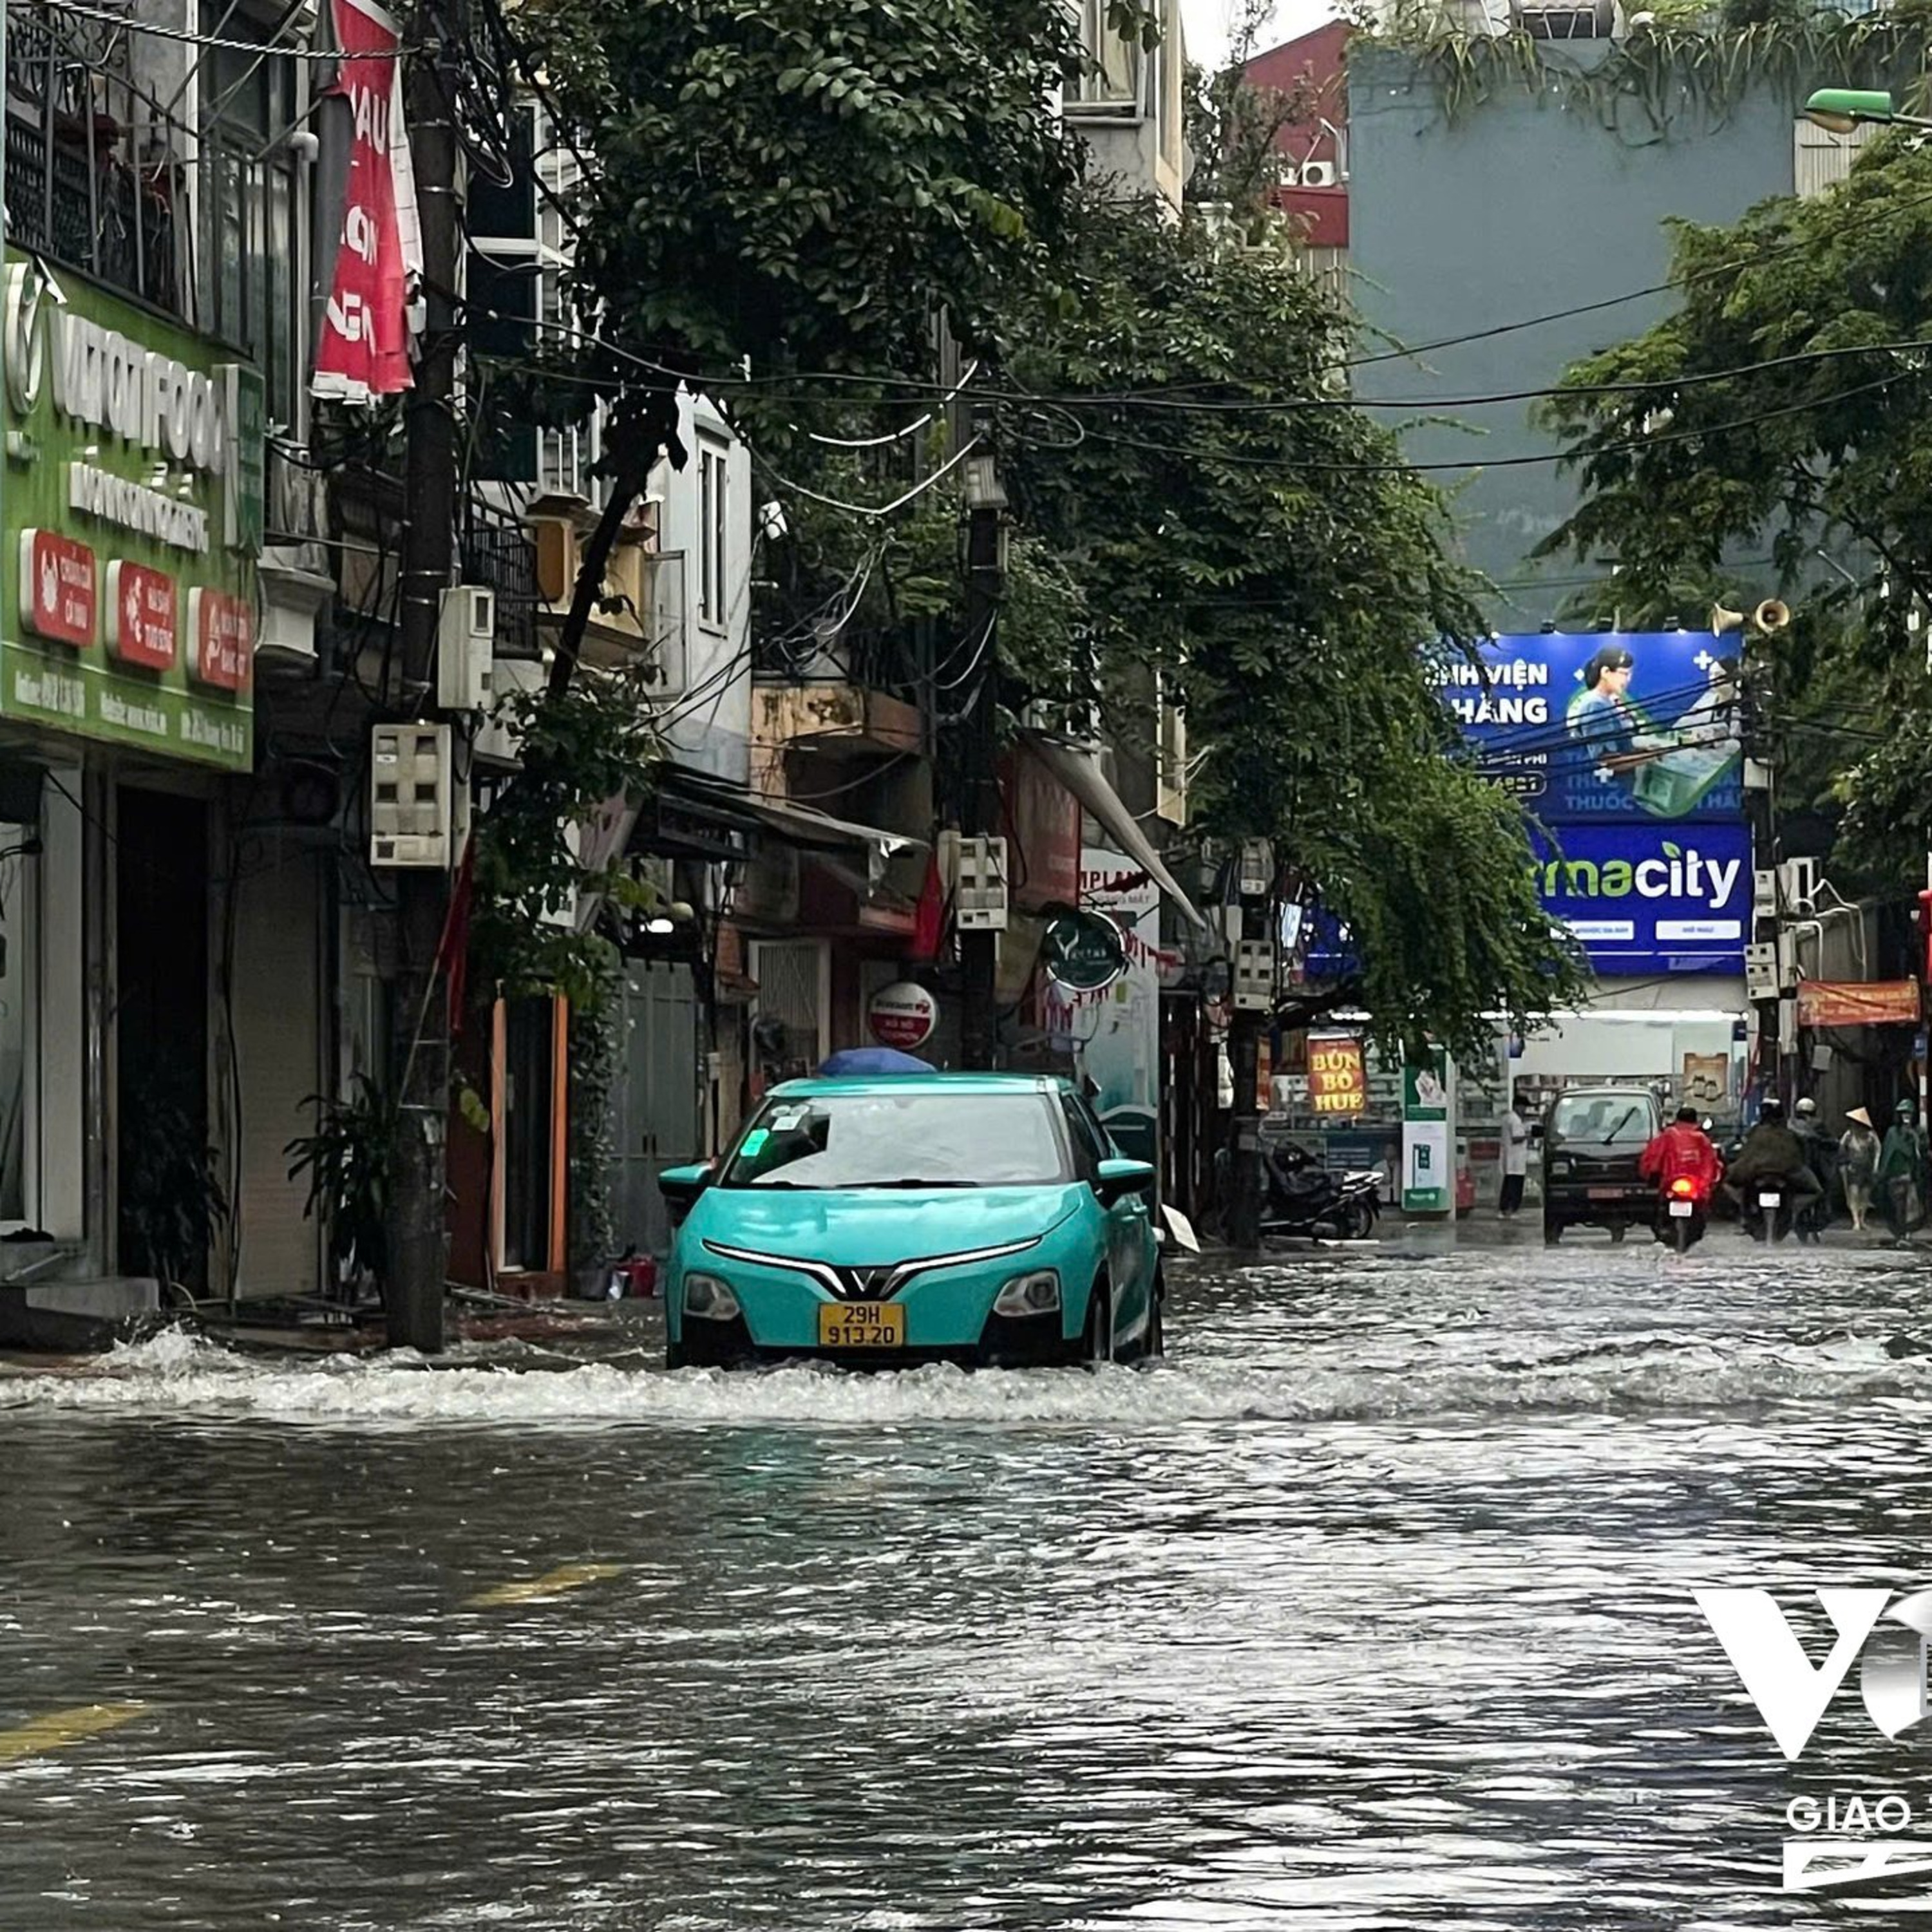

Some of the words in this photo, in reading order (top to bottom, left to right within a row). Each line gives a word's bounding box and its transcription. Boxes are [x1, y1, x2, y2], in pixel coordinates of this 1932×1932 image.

[1484, 658, 1547, 692] VIỆN
[1311, 1048, 1360, 1071] BÚN
[844, 1306, 880, 1324] 29H
